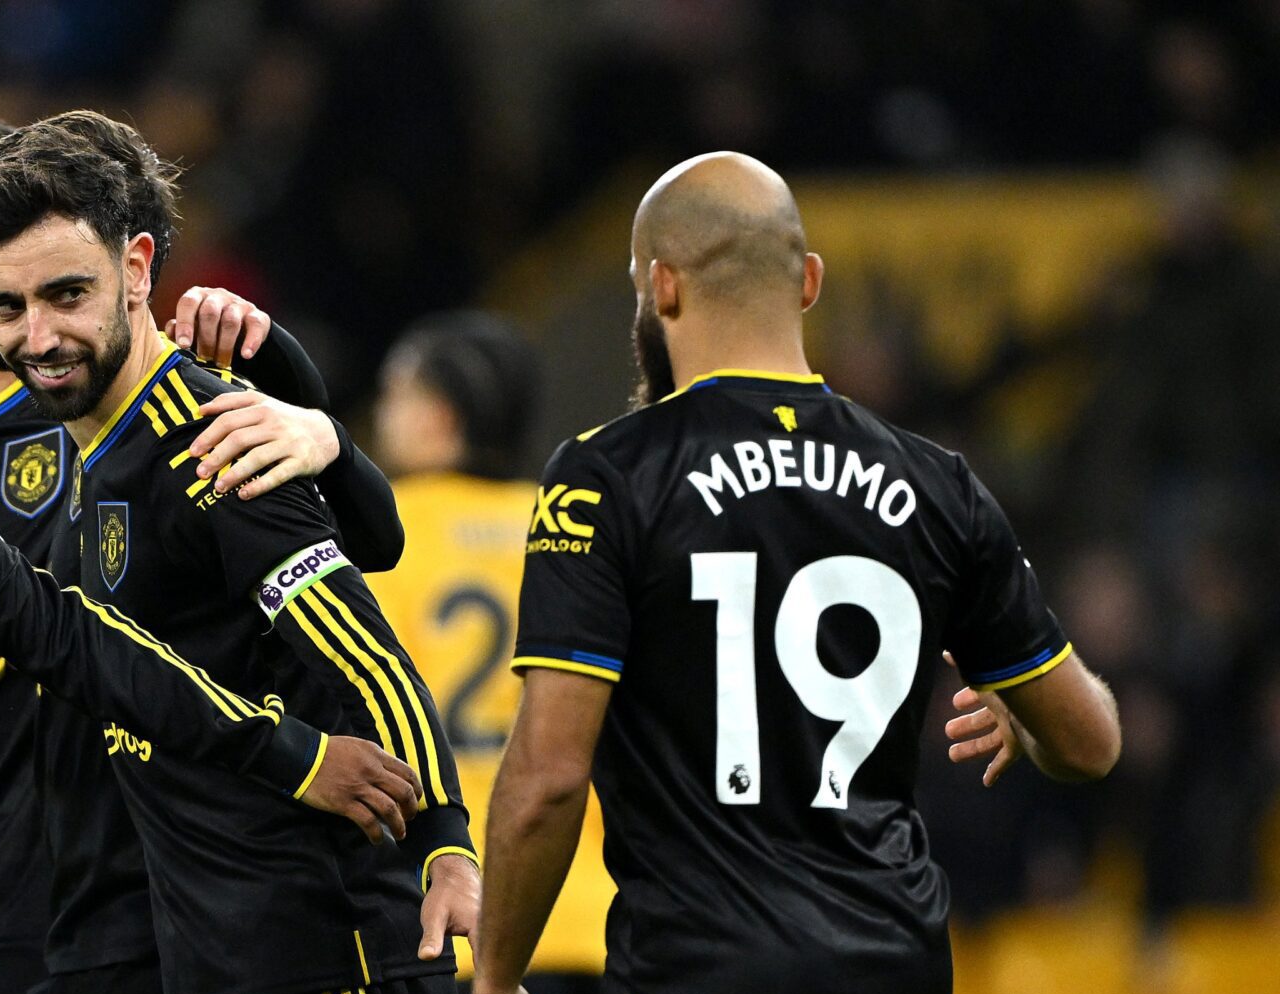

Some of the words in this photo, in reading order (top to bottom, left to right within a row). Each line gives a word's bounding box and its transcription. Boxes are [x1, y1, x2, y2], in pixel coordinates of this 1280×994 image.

[529, 484, 601, 538] XC
[687, 439, 916, 527] MBEUMO
[690, 551, 922, 810] 19
